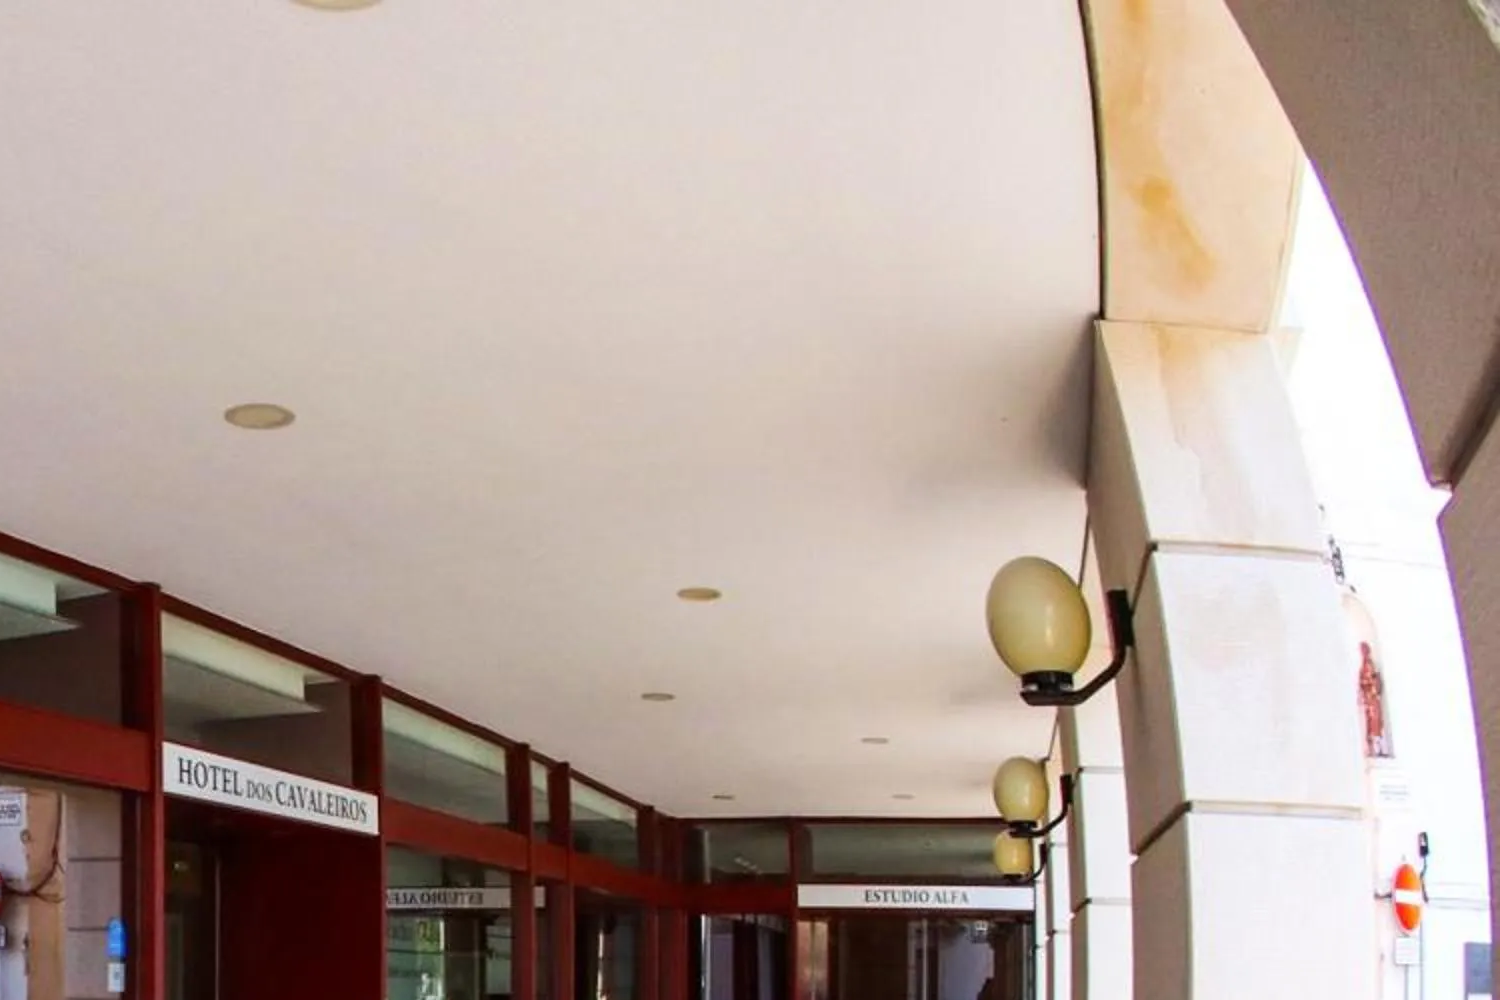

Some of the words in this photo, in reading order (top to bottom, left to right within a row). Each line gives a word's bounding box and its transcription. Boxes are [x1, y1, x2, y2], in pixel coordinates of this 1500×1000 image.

[177, 756, 243, 797] HOTEL
[246, 780, 273, 804] DOS
[275, 781, 367, 824] CAVALEIROS
[864, 889, 930, 903] ESTUDIO
[933, 890, 970, 904] ALFA
